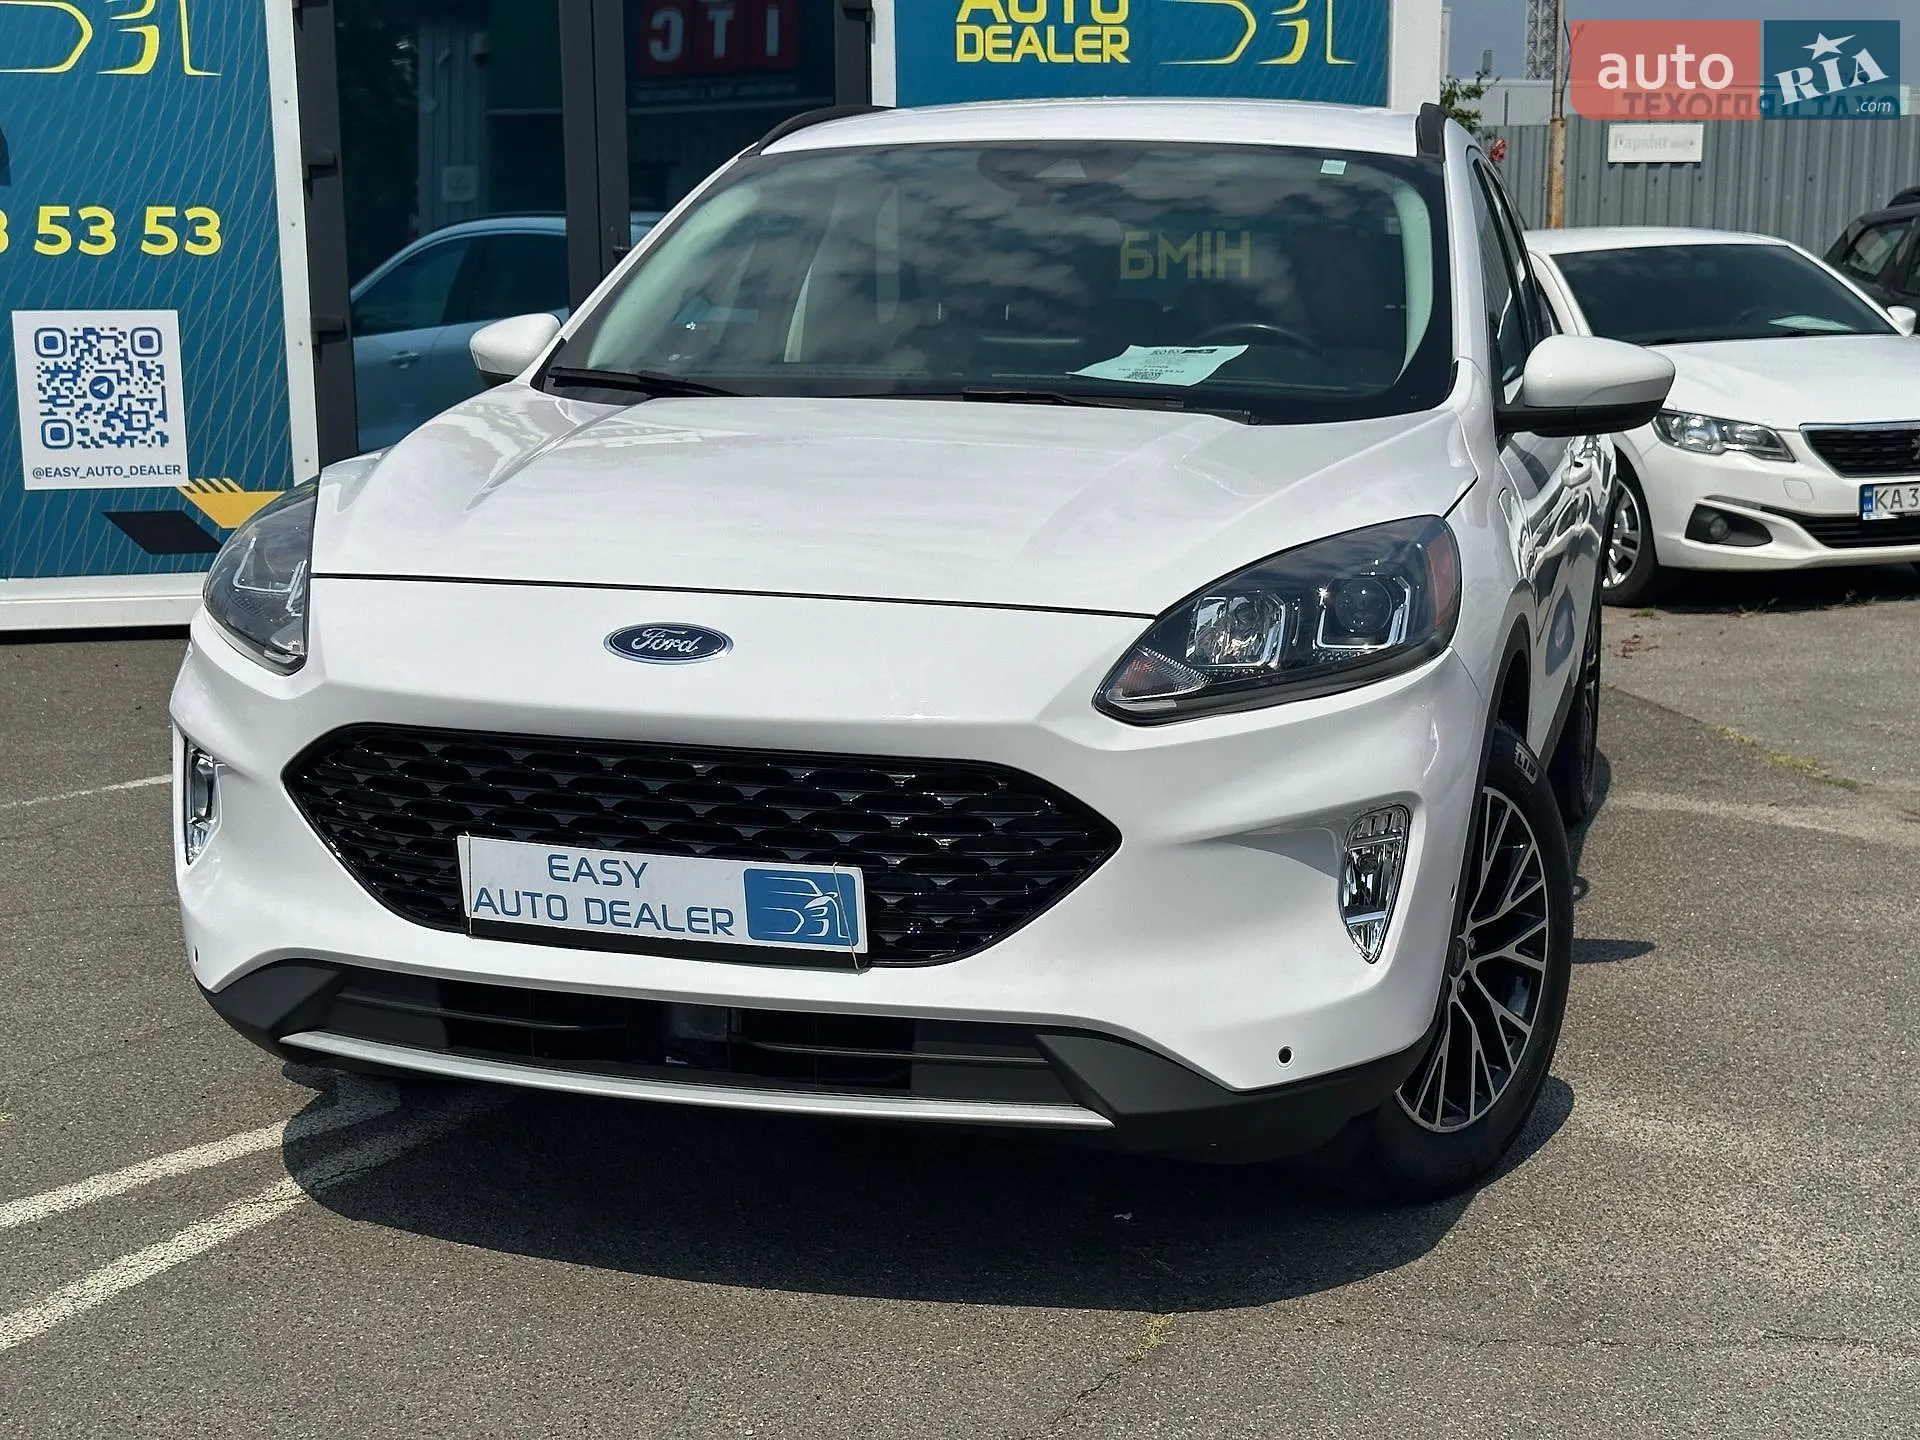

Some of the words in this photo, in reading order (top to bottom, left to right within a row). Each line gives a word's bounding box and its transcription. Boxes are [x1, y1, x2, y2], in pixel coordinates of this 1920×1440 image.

[956, 24, 1131, 63] DEALER
[34, 205, 117, 256] 53
[140, 205, 222, 256] 53
[32, 464, 182, 479] @EASY_AUTO_DEALER
[1875, 488, 1903, 510] KA
[631, 627, 704, 653] Ford
[547, 854, 649, 888] EASY
[473, 887, 569, 921] AUTO
[584, 897, 735, 936] DEALER
